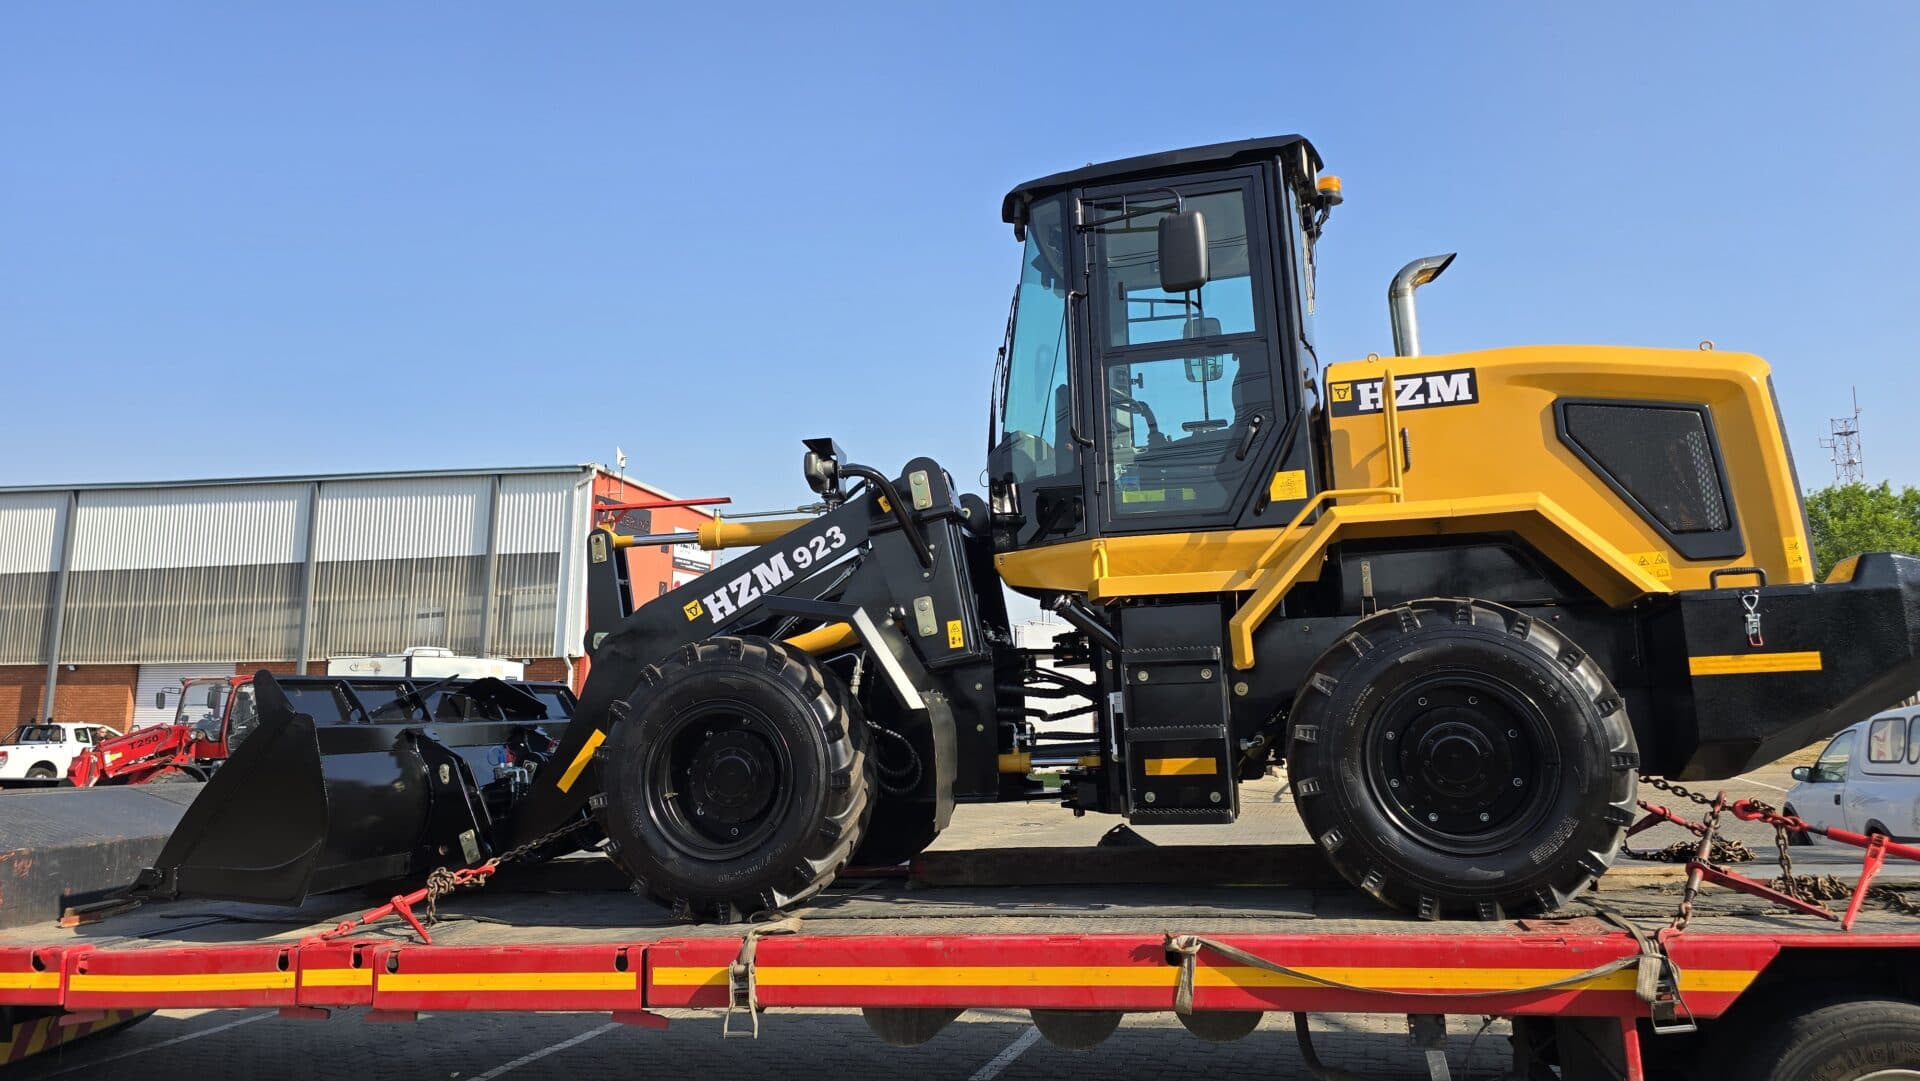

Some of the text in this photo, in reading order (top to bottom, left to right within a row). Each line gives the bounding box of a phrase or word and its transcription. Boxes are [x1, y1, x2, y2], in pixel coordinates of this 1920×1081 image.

[1357, 373, 1472, 410] HZM
[703, 525, 847, 624] HZM 923
[128, 736, 159, 750] T250
